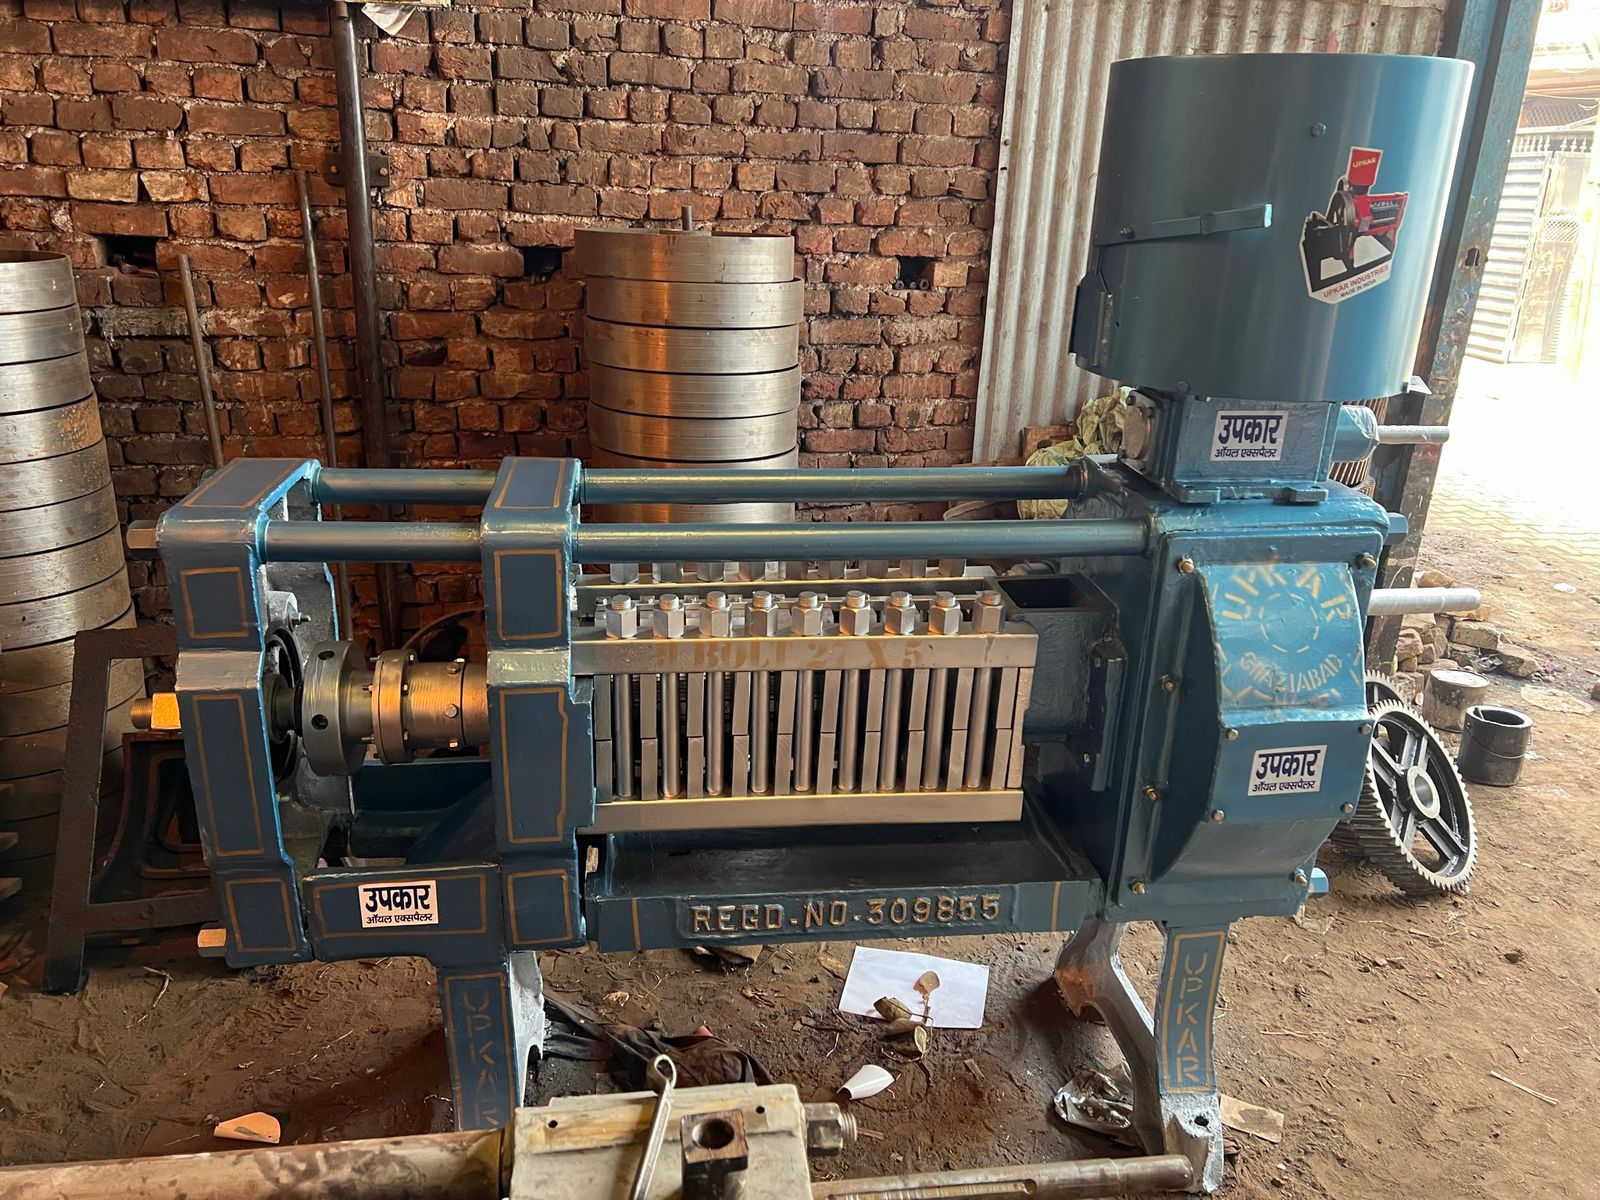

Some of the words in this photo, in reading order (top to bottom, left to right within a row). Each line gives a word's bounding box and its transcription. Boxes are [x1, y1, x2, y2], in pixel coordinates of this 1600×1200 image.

[1352, 157, 1377, 168] UPKAR
[1323, 282, 1349, 298] UPKAR
[1350, 264, 1389, 286] INDUSTRIES
[1340, 288, 1356, 297] MADE
[1363, 279, 1377, 288] INDIA
[1218, 415, 1283, 444] उपकार
[1214, 446, 1240, 457] ऑयल
[1240, 652, 1343, 693] GHAZIABAD
[1256, 749, 1321, 780] उपकार
[1252, 781, 1277, 792] ऑयल
[363, 885, 431, 912] उपकार
[366, 914, 392, 924] ऑयल
[1176, 952, 1208, 1083] UPKAR
